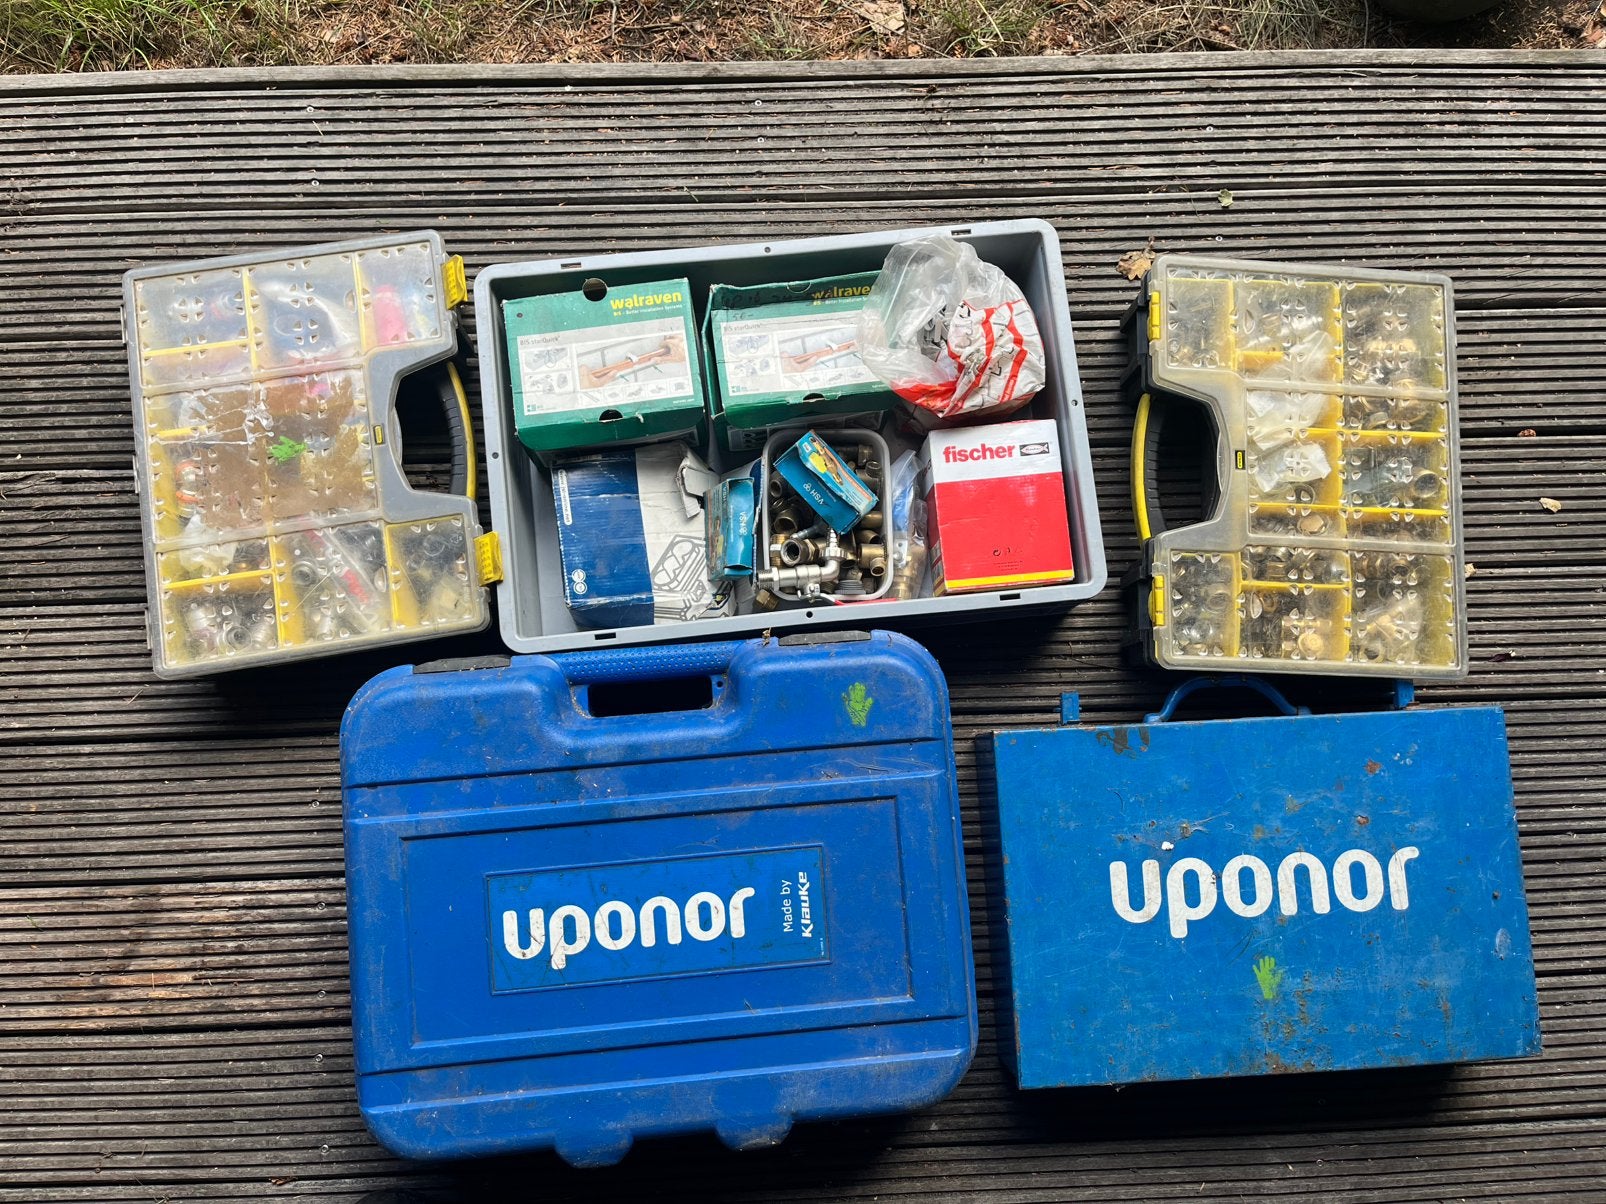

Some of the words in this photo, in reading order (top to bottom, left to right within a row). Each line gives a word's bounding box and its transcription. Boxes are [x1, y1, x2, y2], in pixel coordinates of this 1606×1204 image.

[610, 292, 682, 309] walraven
[811, 285, 871, 299] walrave
[943, 443, 1016, 463] fischer
[780, 879, 792, 895] by
[1109, 846, 1420, 939] uponor
[781, 898, 794, 932] Made
[502, 887, 755, 970] uponor
